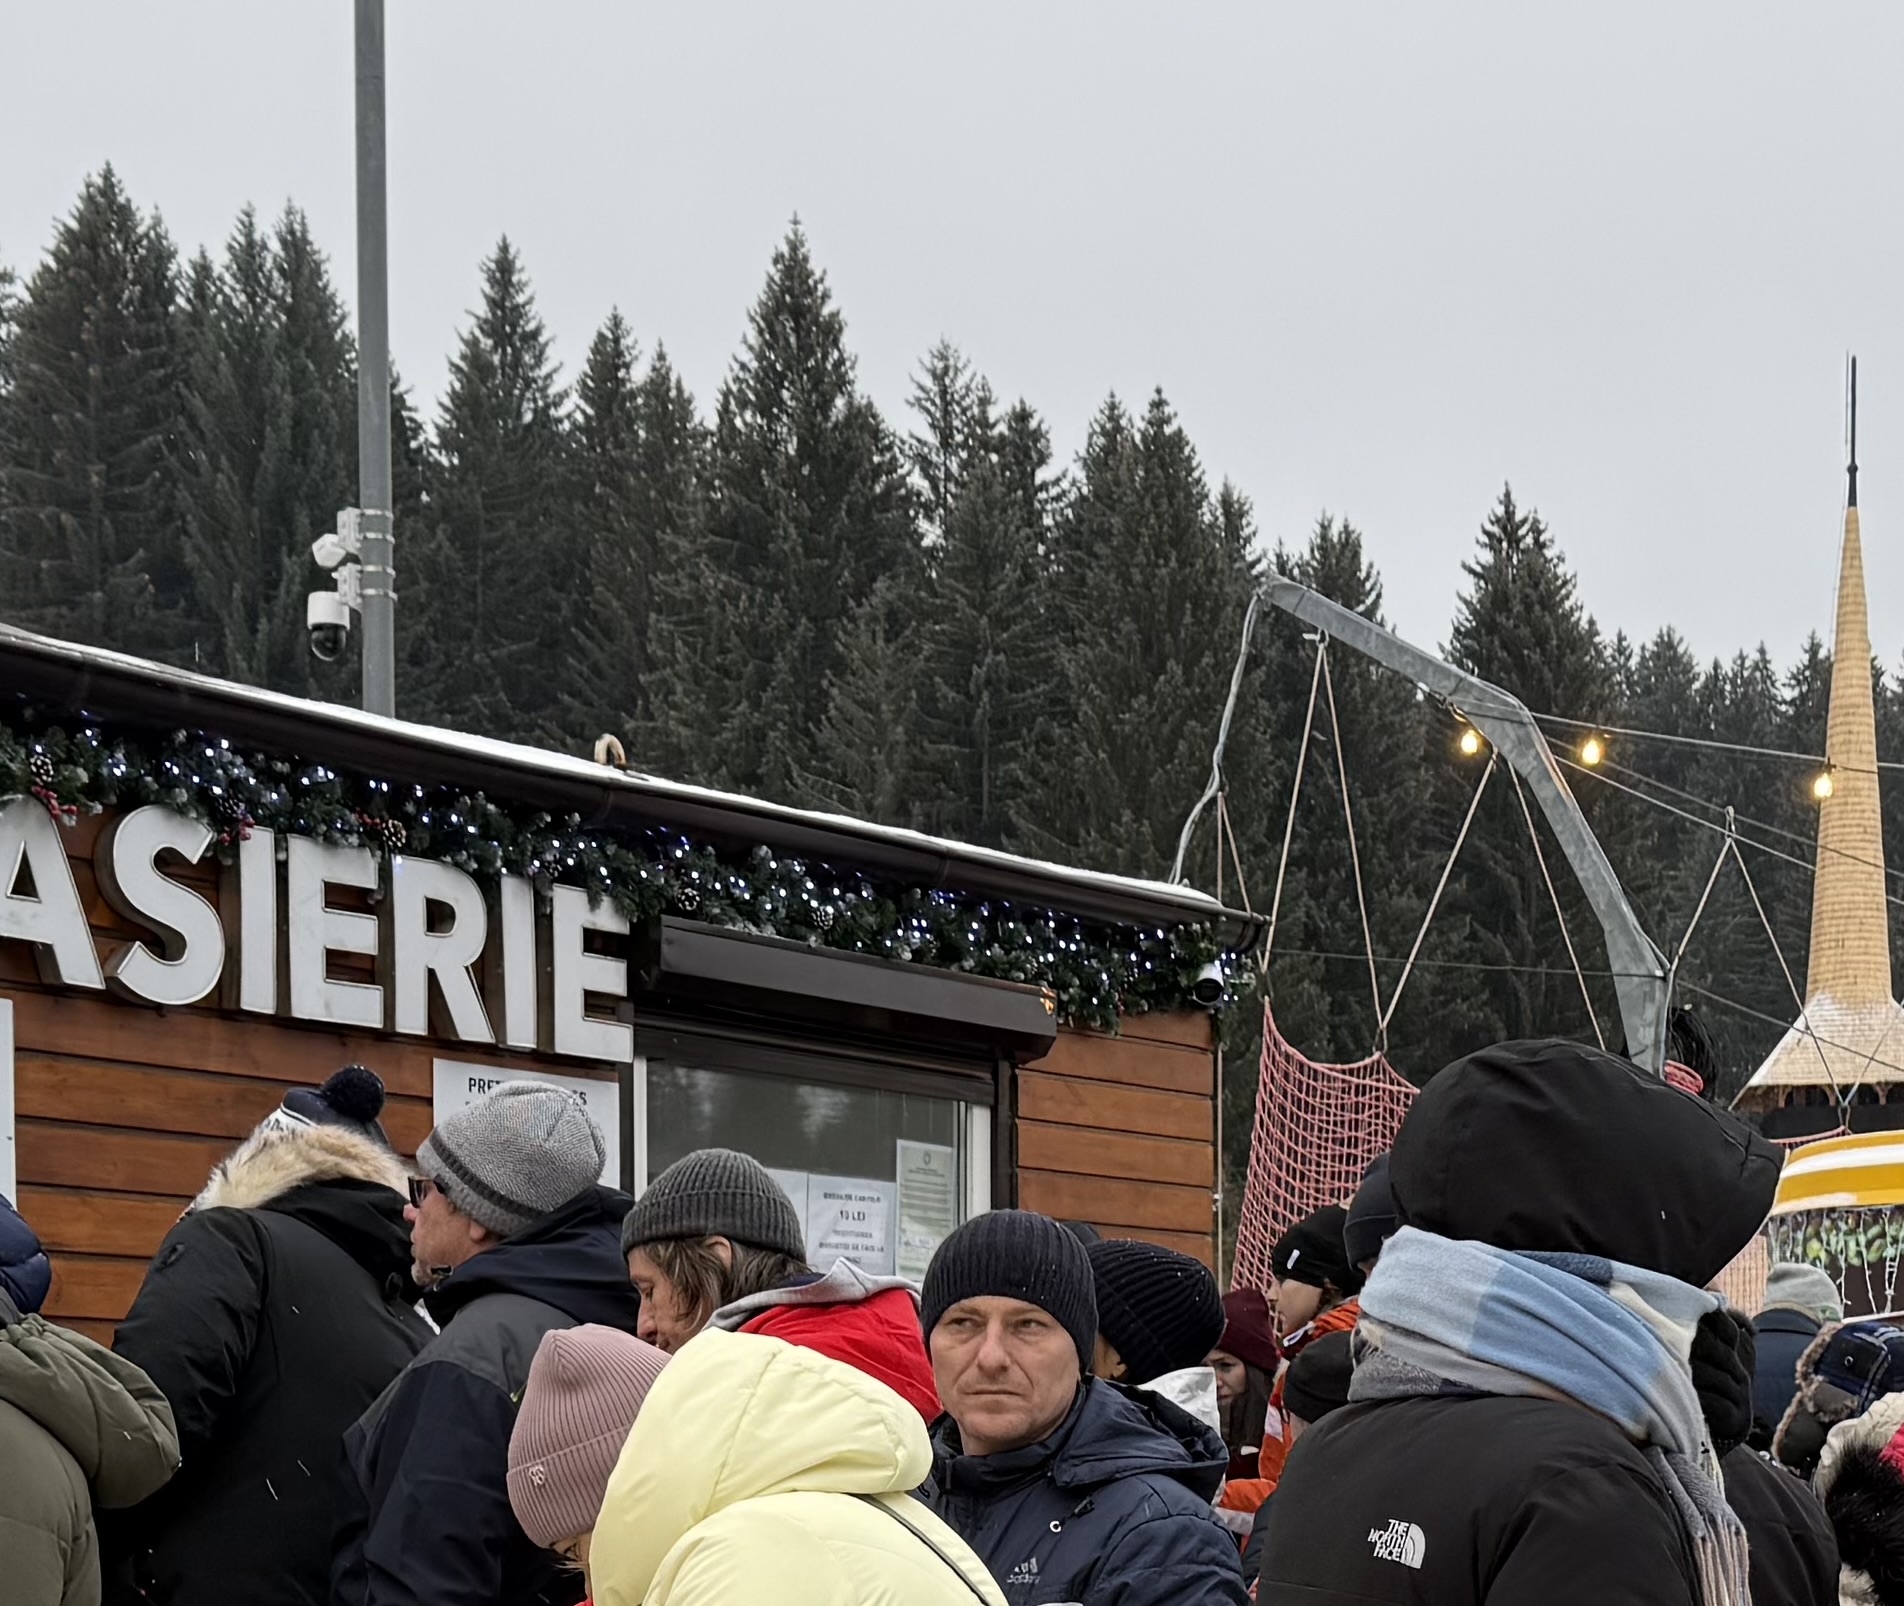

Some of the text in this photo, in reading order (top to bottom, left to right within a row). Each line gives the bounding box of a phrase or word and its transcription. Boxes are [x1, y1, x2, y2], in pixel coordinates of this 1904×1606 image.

[1388, 1518, 1409, 1534] THE
[1367, 1527, 1406, 1551] NORTH
[1373, 1541, 1402, 1562] FACE
